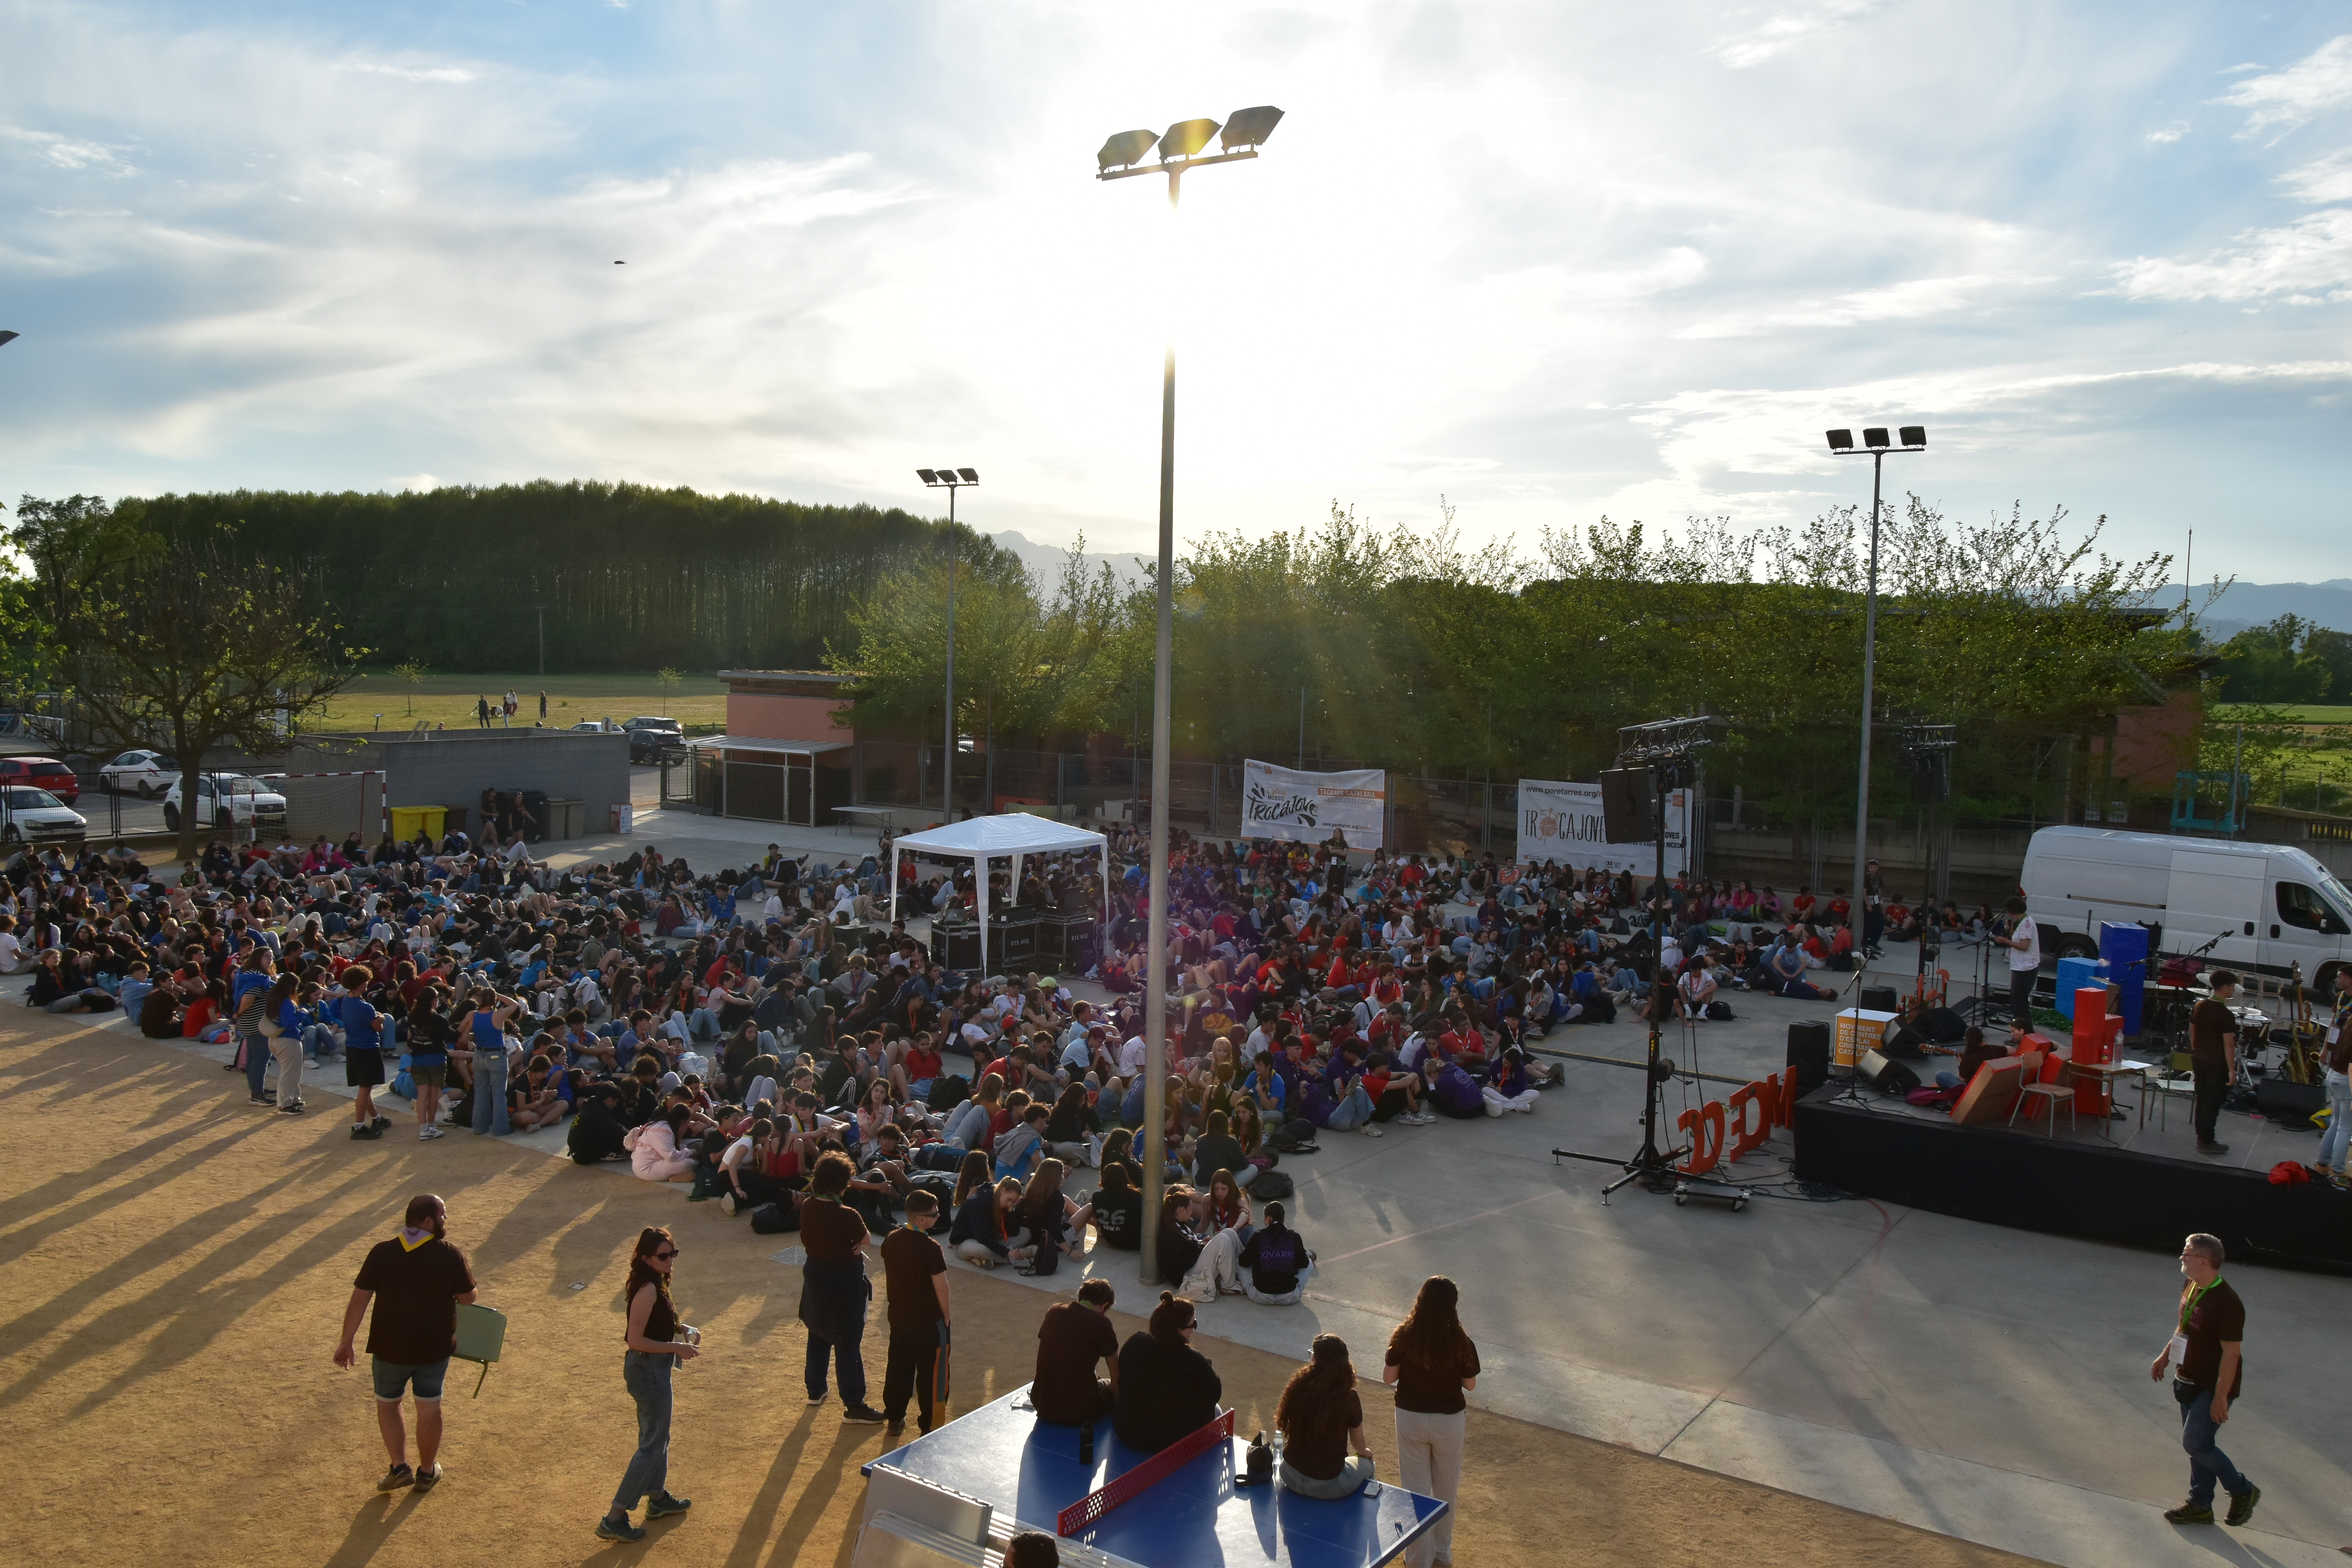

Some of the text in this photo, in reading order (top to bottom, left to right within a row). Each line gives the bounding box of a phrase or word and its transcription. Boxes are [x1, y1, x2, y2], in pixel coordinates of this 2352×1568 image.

[1323, 822, 1372, 830] www.peretarres.org/mcecc
[1840, 1023, 1876, 1032] MOVMENT
[1850, 1031, 1881, 1040] CENTRES
[1096, 1209, 1125, 1225] 26
